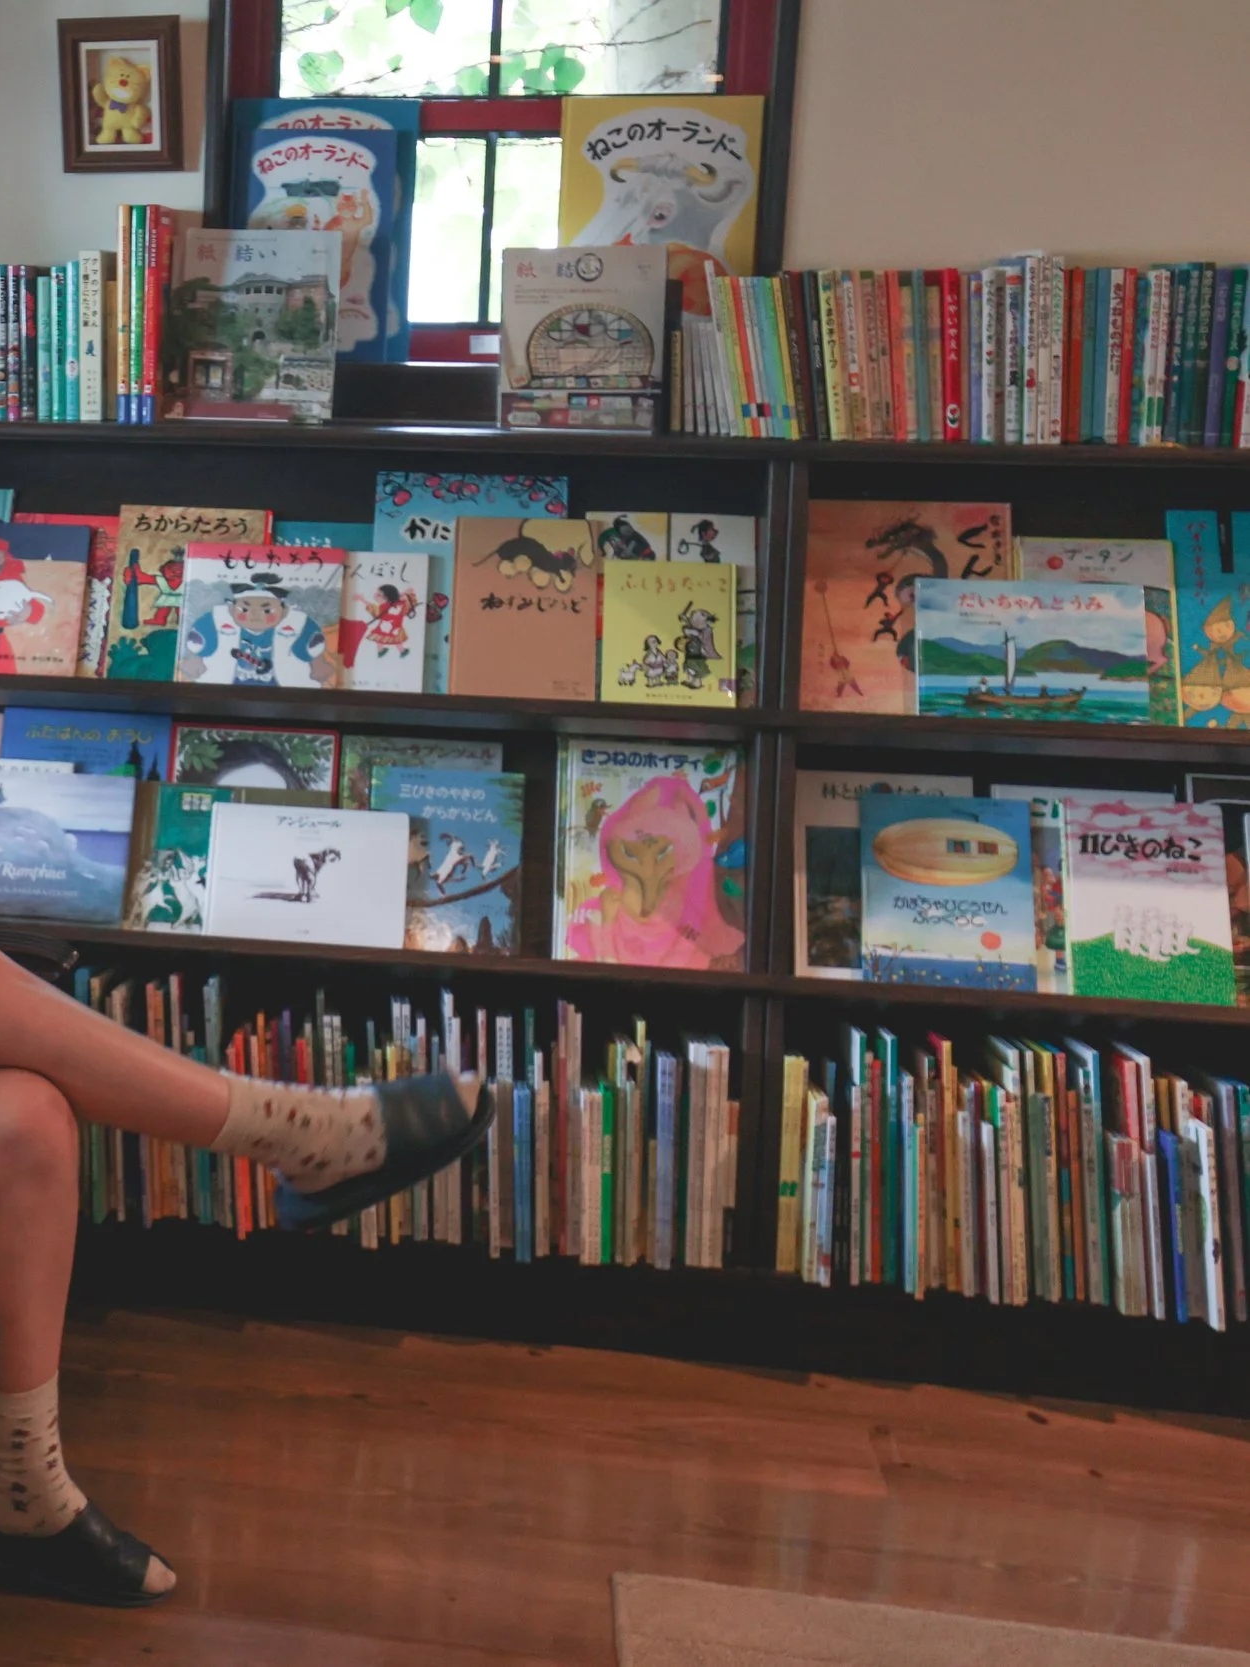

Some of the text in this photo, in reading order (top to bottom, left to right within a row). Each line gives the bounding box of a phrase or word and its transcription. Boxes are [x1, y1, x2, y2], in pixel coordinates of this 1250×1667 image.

[587, 118, 743, 161] ねこのオーランドー
[257, 143, 370, 174] ねこのオーランドー
[134, 513, 248, 535] ちからたろう
[219, 549, 324, 572] ももたろう
[620, 573, 728, 594] ふしぎなたいこ
[480, 592, 588, 614] ねずみじょうど
[959, 591, 1104, 610] だいちゃんとうみ
[581, 749, 701, 770] きつねのホイティ
[398, 783, 486, 802] 三びきのやぎの
[276, 815, 342, 828] アンジュール
[422, 805, 497, 823] がらがらどん
[1078, 832, 1203, 861] 11ぴきのねこ
[893, 894, 1008, 915] かぼちゃひこうせん
